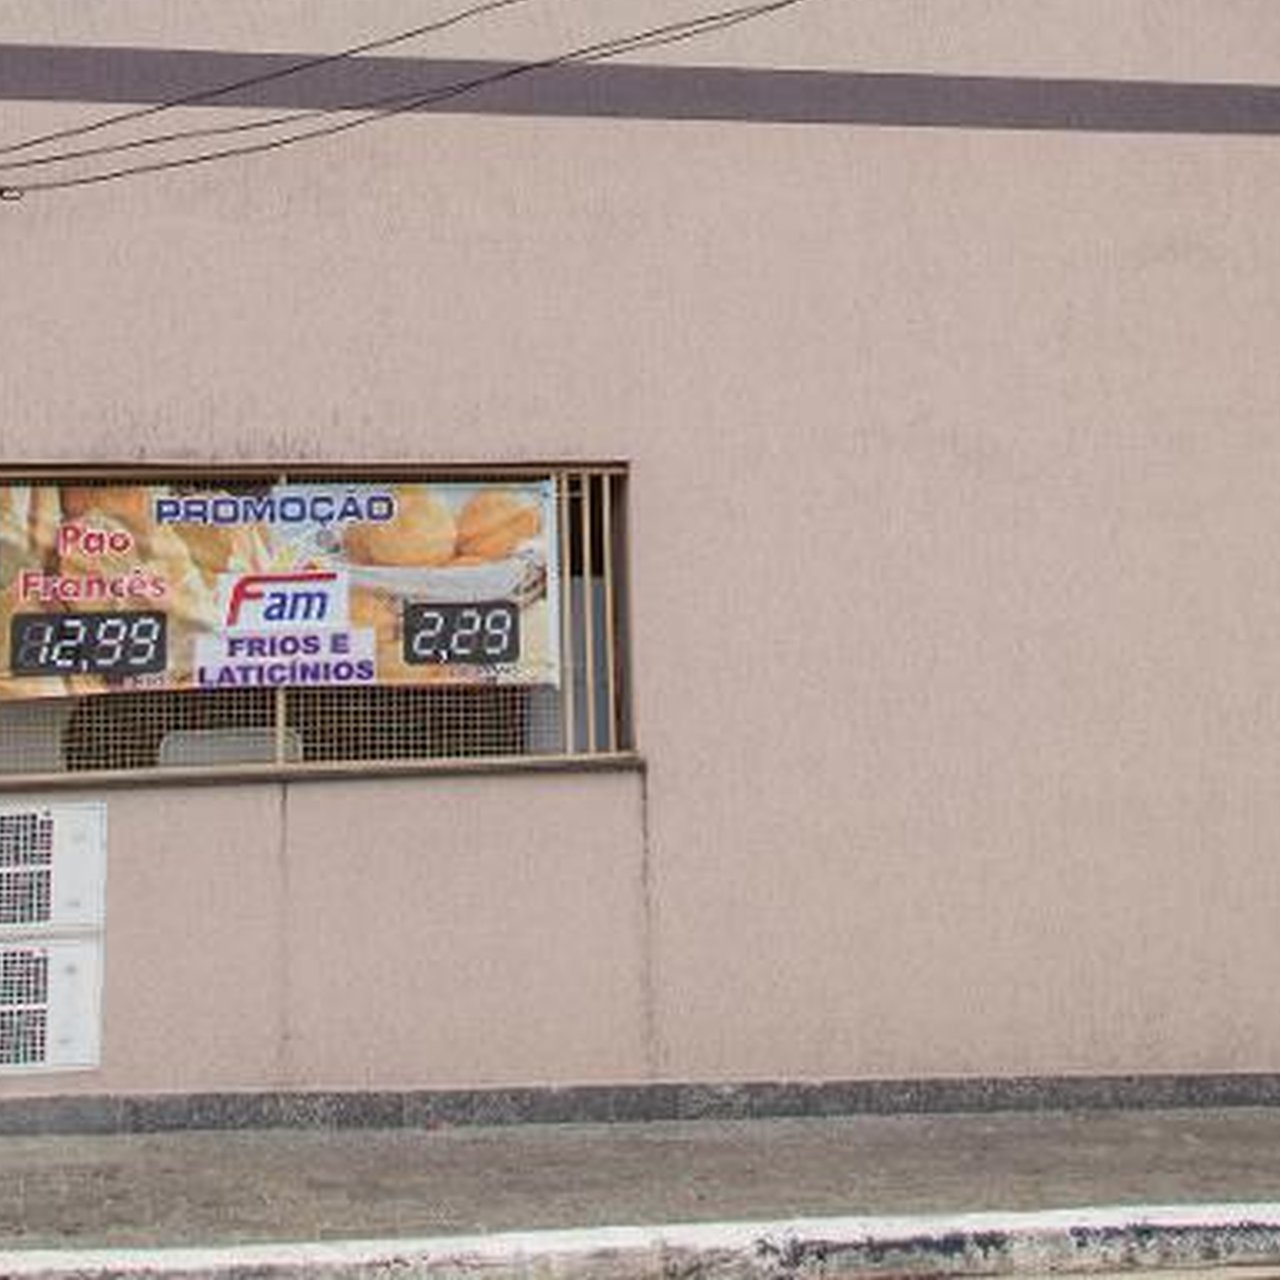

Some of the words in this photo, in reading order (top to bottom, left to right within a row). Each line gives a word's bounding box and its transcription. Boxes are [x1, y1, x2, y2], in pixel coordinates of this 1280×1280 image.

[156, 490, 394, 524] PROMOÇÃO
[22, 570, 166, 600] Francês
[226, 572, 338, 627] Fam
[38, 617, 160, 671] 12,99
[227, 635, 321, 657] FRIOS
[330, 633, 350, 654] E
[412, 609, 512, 663] 2,29
[199, 658, 375, 684] LATICÍNIOS
